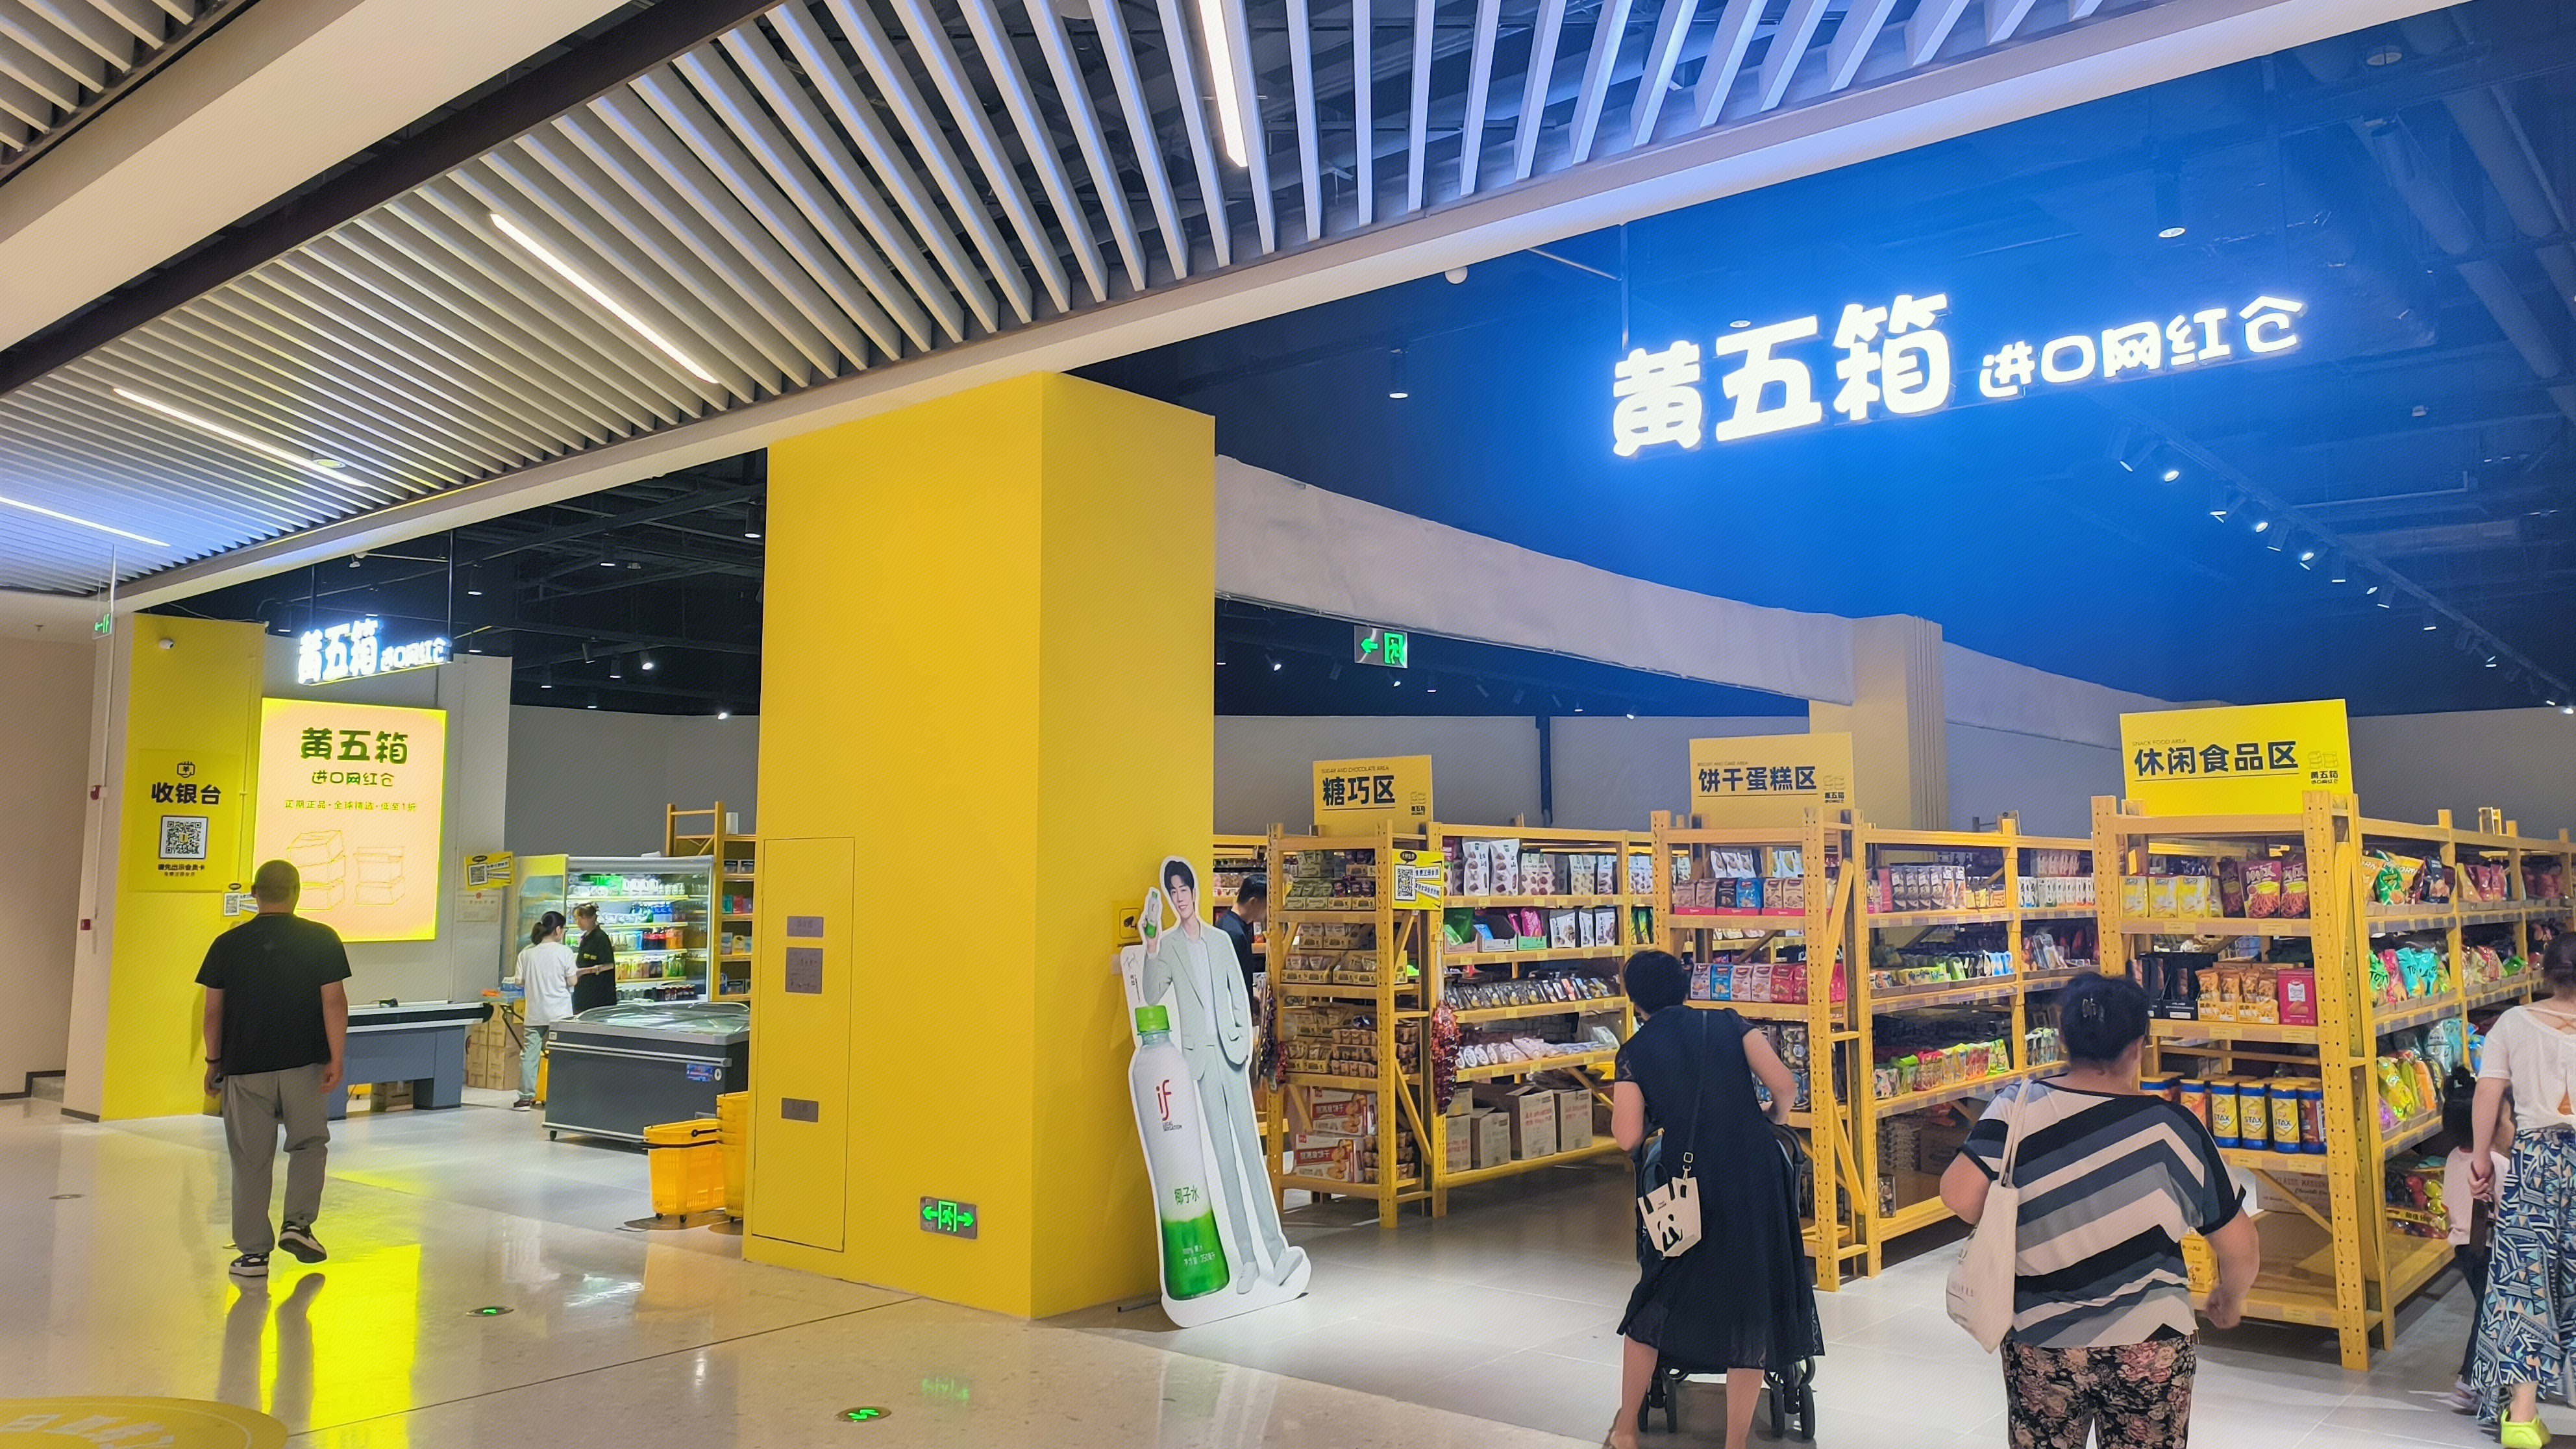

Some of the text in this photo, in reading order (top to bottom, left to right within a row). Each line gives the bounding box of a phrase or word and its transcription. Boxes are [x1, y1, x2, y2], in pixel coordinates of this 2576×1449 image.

[1613, 293, 2303, 457] 黄五箱 进口网红仓
[298, 619, 378, 684] 黄五箱
[301, 727, 408, 764] 黄五箱
[2135, 741, 2299, 776] 休闲食品区
[151, 782, 221, 804] 收银台
[312, 770, 394, 786] 进口网红仓
[1322, 775, 1395, 806] 糖巧区
[1698, 765, 1817, 792] 饼干蛋糕区
[1156, 1080, 1172, 1121] if
[1174, 1185, 1199, 1205] 椰子水
